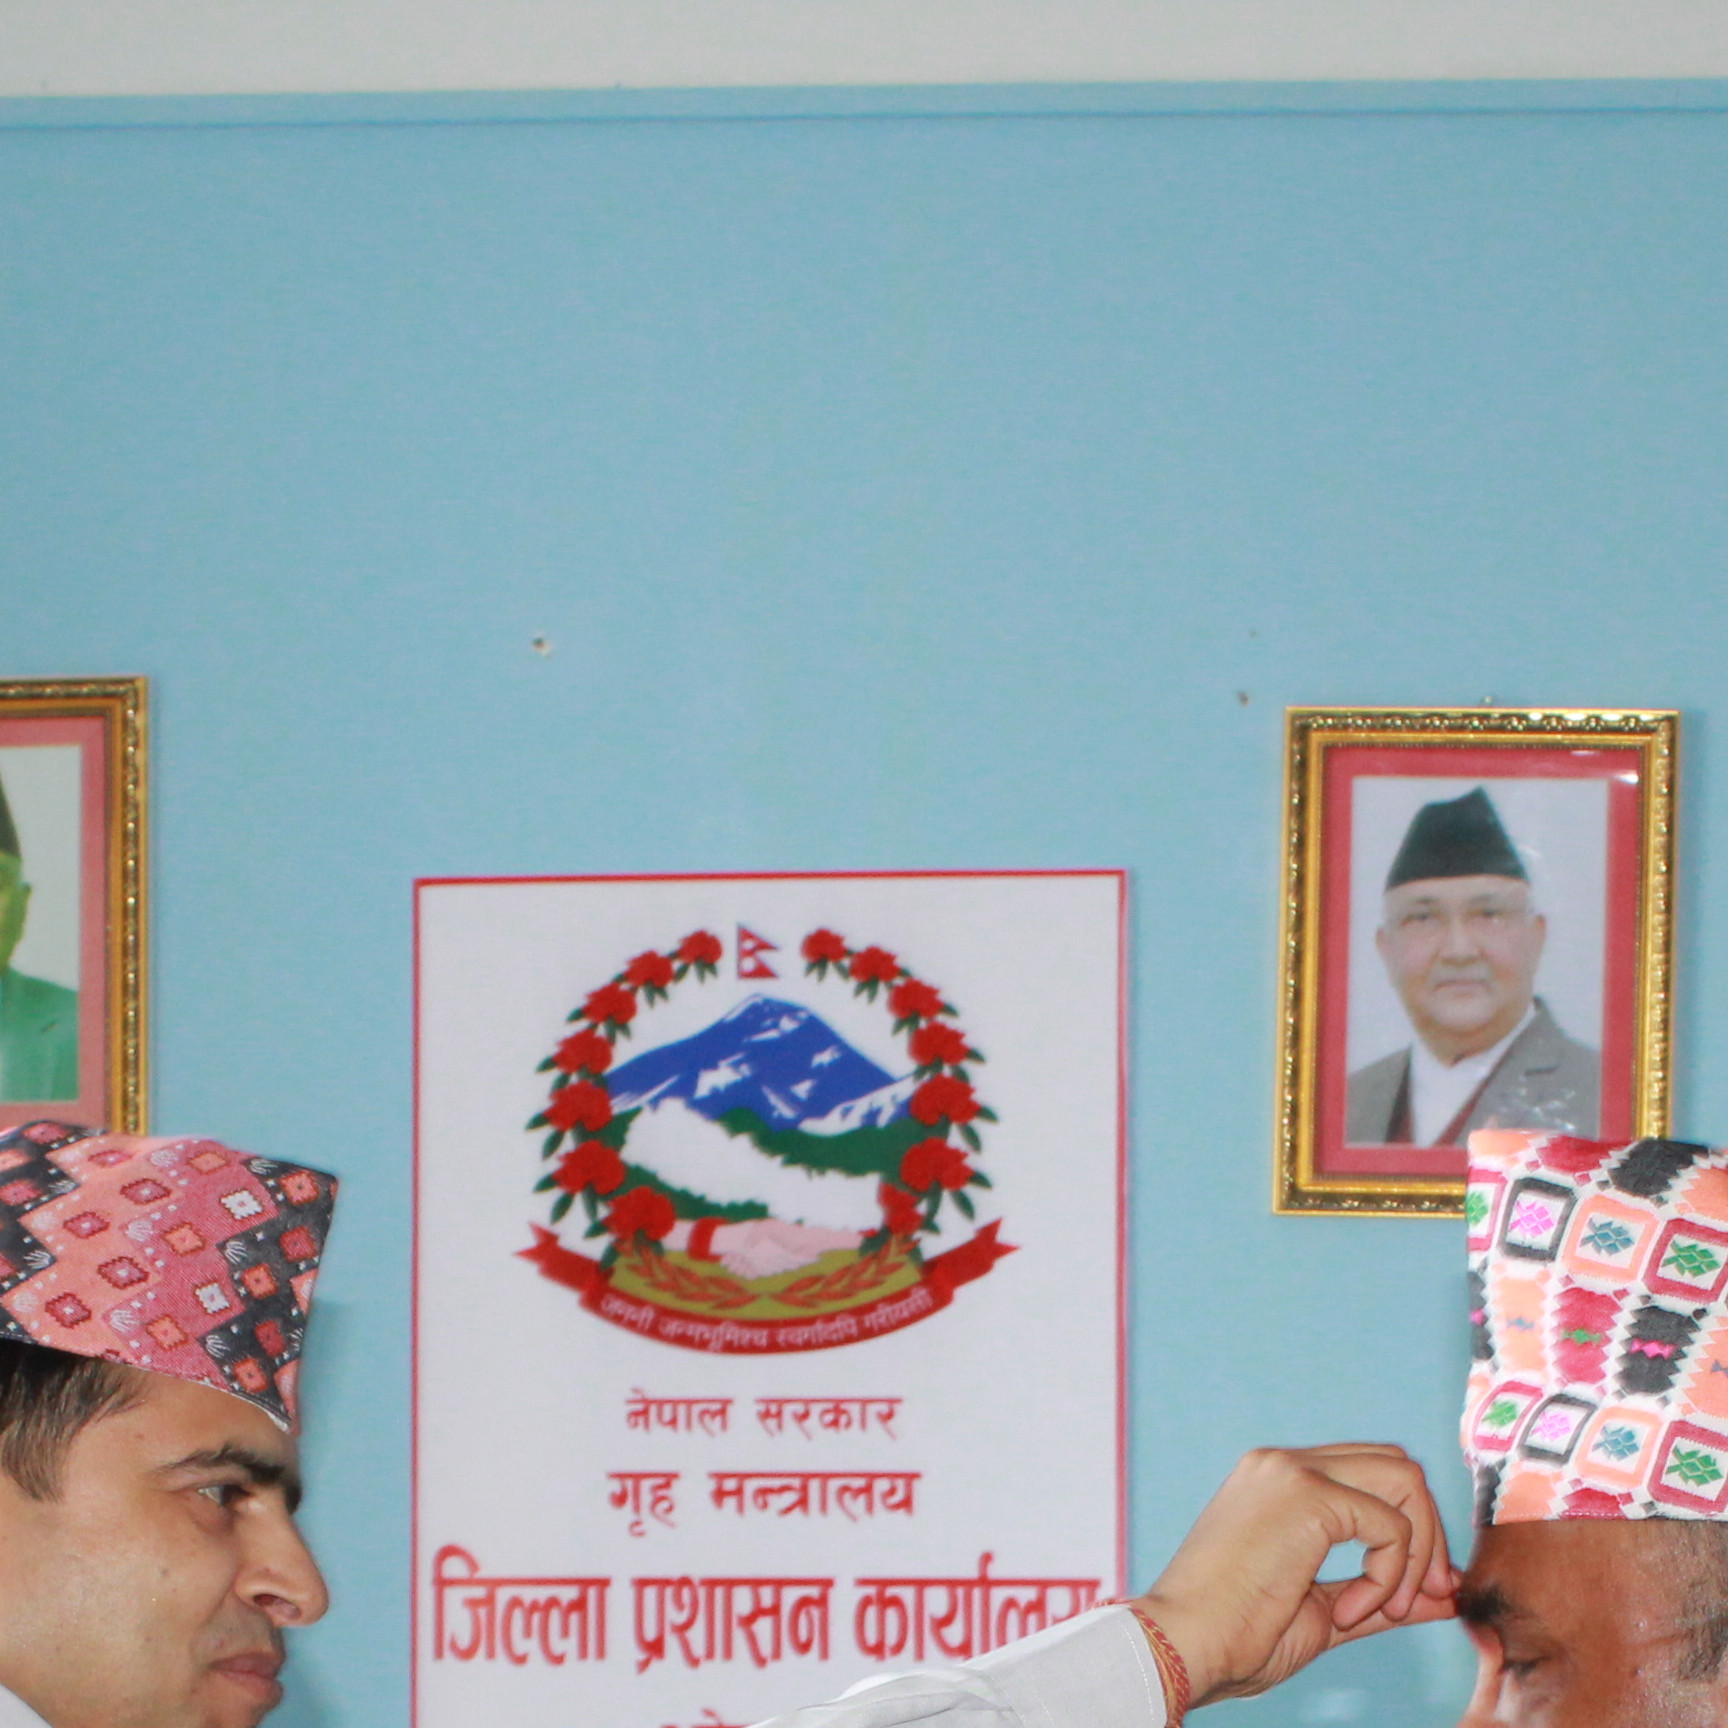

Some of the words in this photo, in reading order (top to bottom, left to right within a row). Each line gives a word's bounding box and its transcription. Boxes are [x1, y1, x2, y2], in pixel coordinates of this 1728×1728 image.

[600, 1292, 655, 1332] जननी
[625, 1388, 734, 1438] नेपाल
[754, 1397, 903, 1440] सरकार
[606, 1471, 680, 1537] गृह
[708, 1471, 922, 1523] मन्त्रालय
[432, 1544, 611, 1667] जिल्ला
[631, 1575, 835, 1675] प्रशासन
